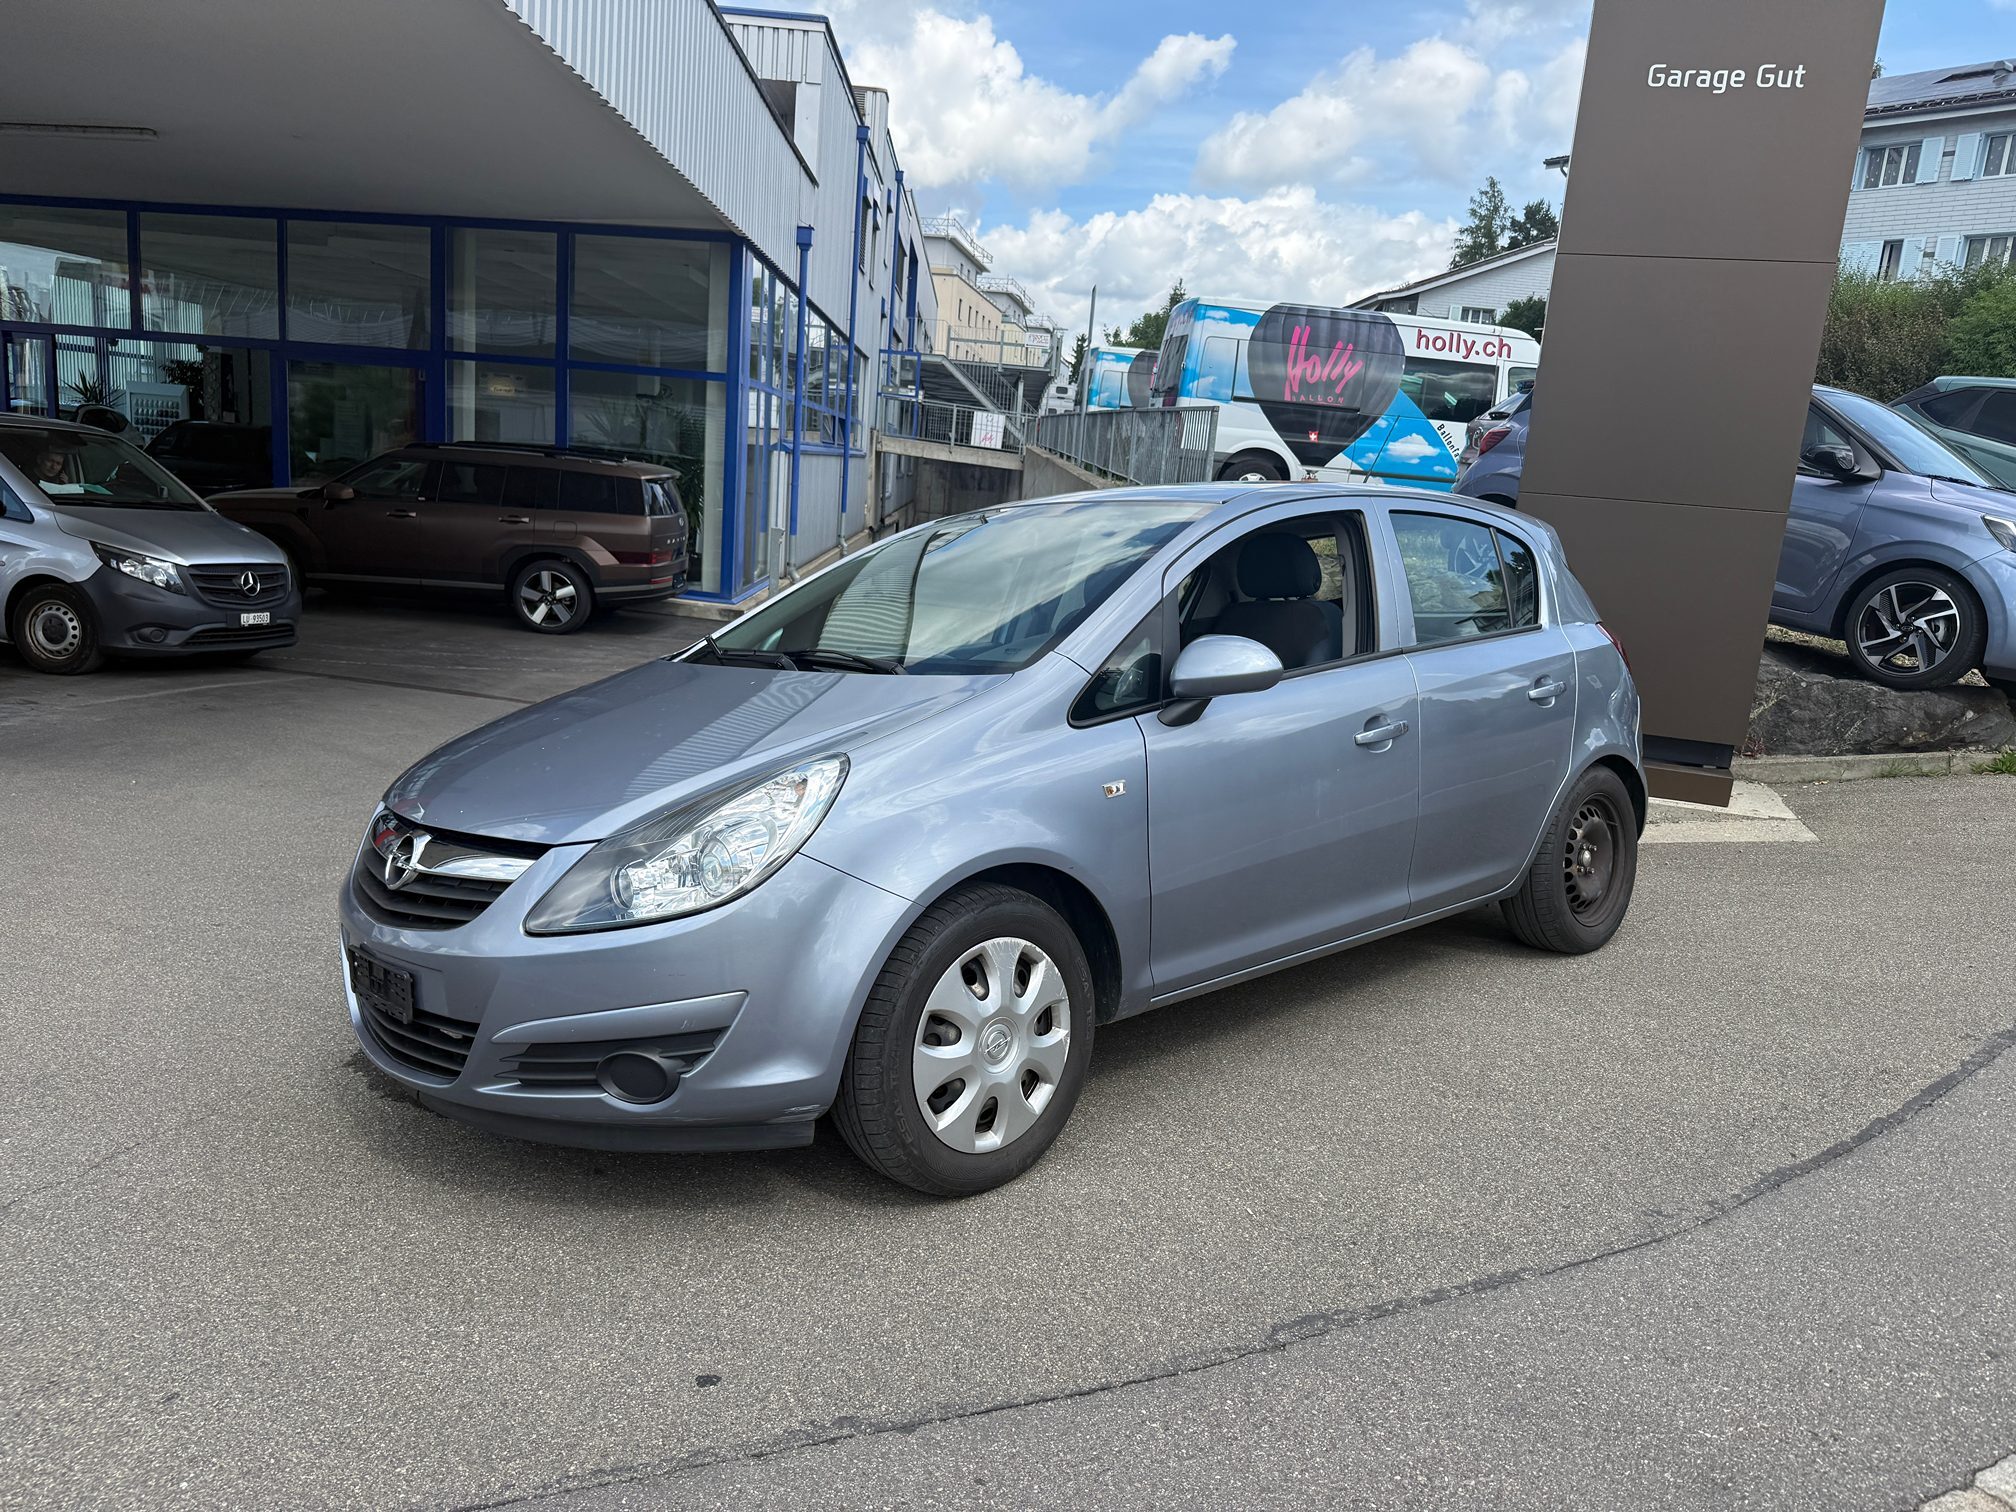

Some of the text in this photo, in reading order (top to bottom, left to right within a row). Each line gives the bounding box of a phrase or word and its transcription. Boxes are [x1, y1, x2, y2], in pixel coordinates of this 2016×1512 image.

[1647, 63, 1806, 94] Garage Gut
[1416, 328, 1512, 360] holly.ch
[1284, 325, 1363, 401] Holly
[1437, 423, 1460, 459] Ballonfa
